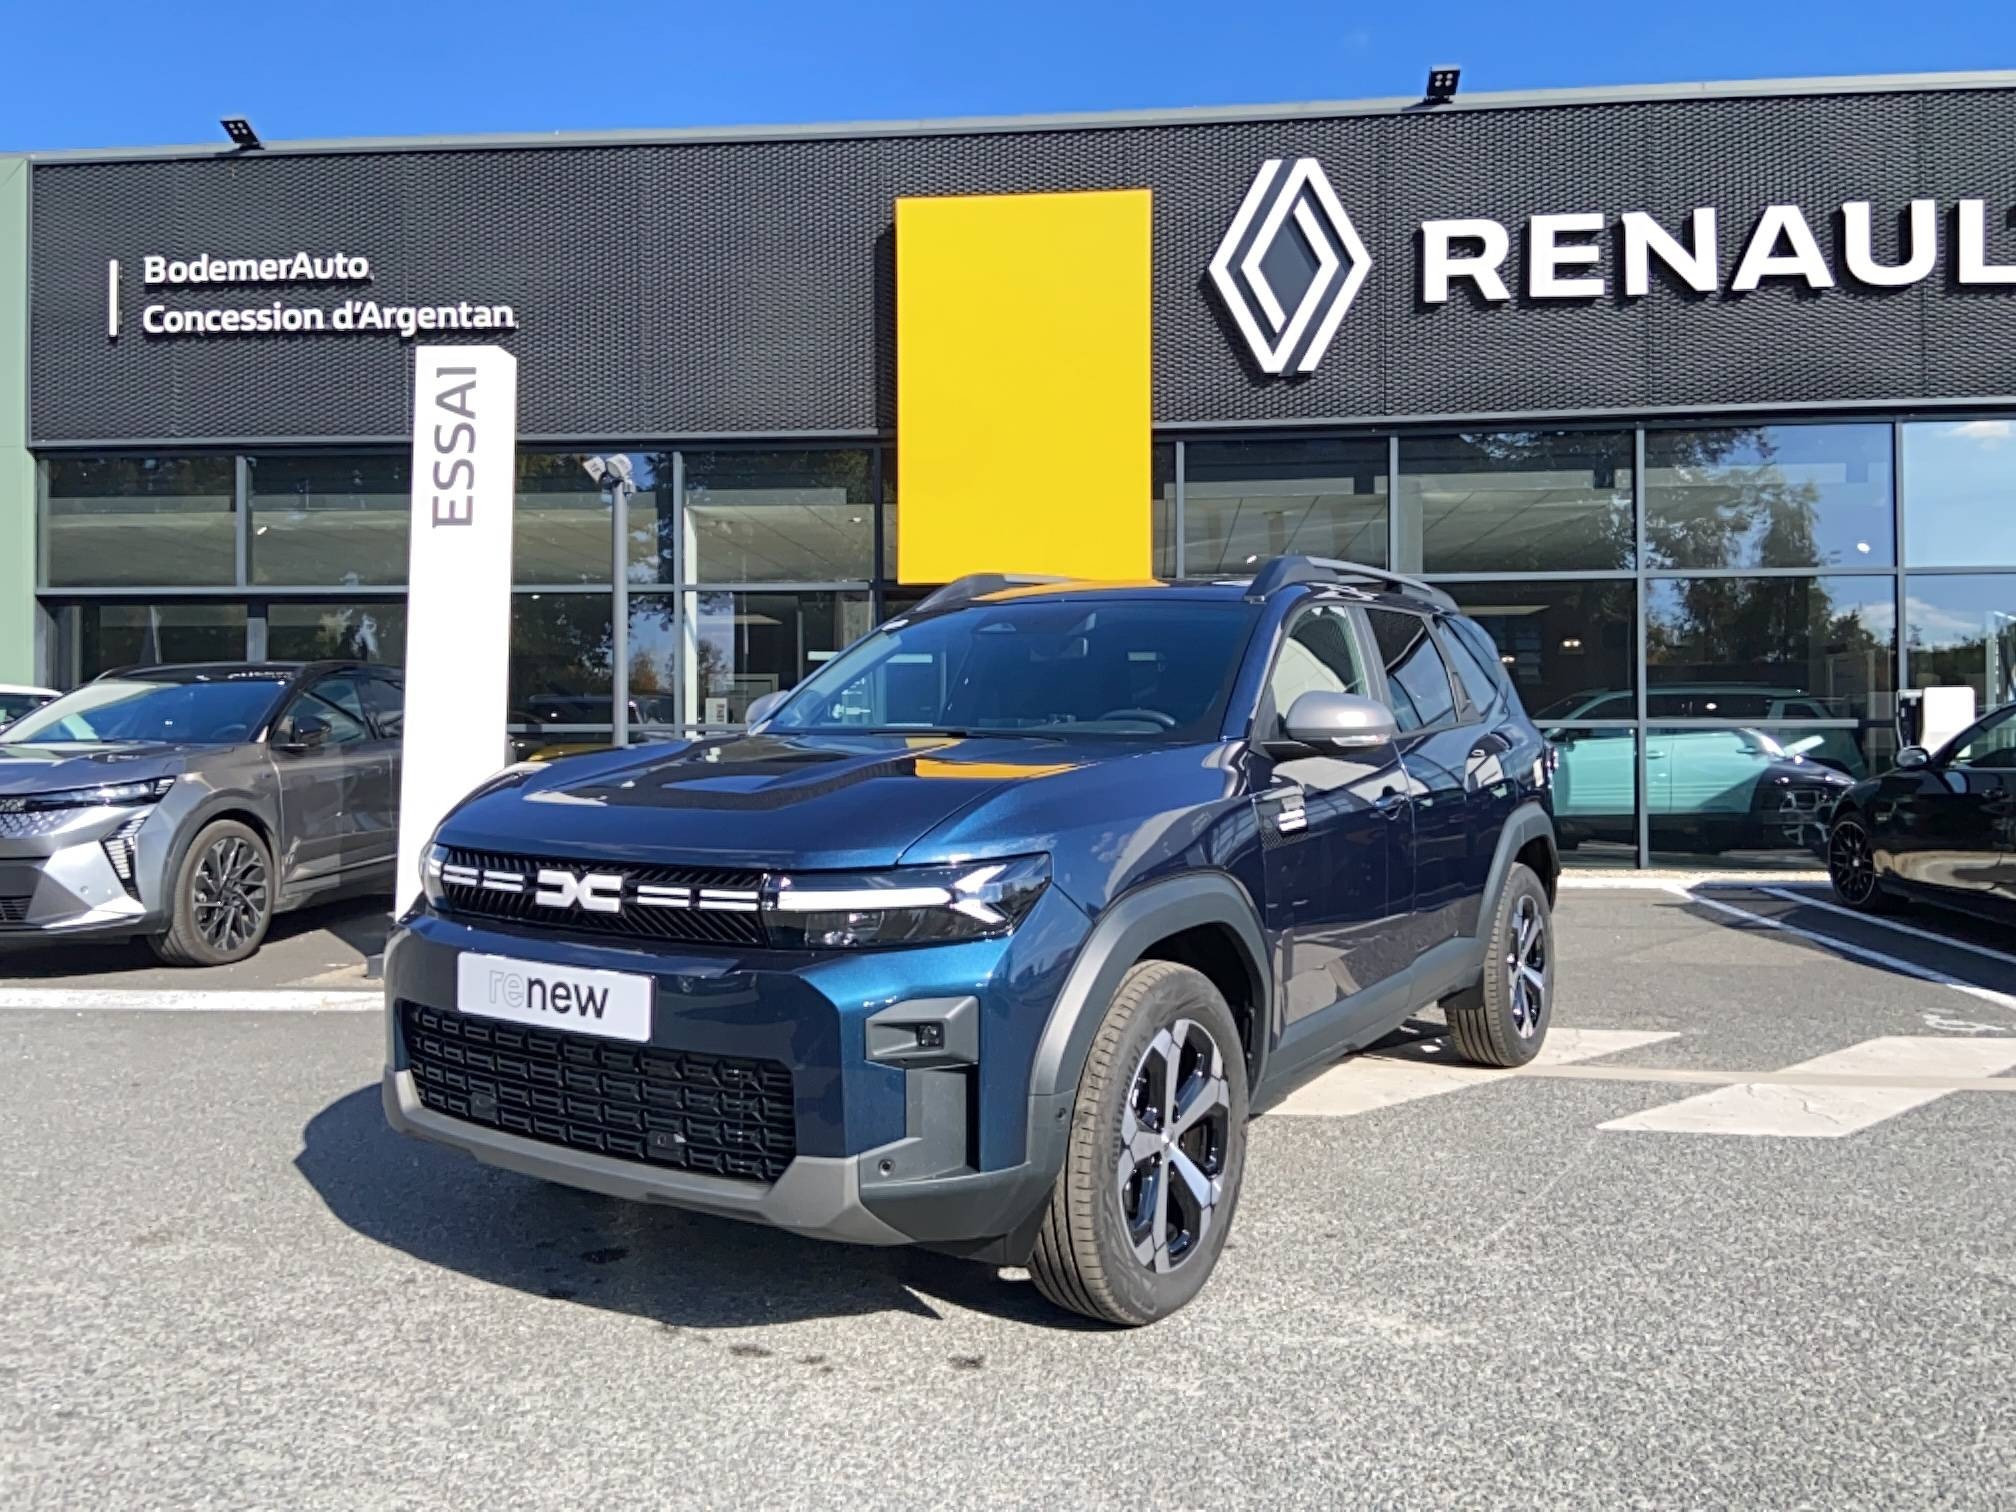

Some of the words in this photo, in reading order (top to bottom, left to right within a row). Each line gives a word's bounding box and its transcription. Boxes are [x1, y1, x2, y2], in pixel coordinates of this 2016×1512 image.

[144, 252, 370, 283] BodemerAuto
[143, 302, 325, 334] Concession
[432, 367, 476, 528] ESSAI
[489, 970, 609, 1019] renew
